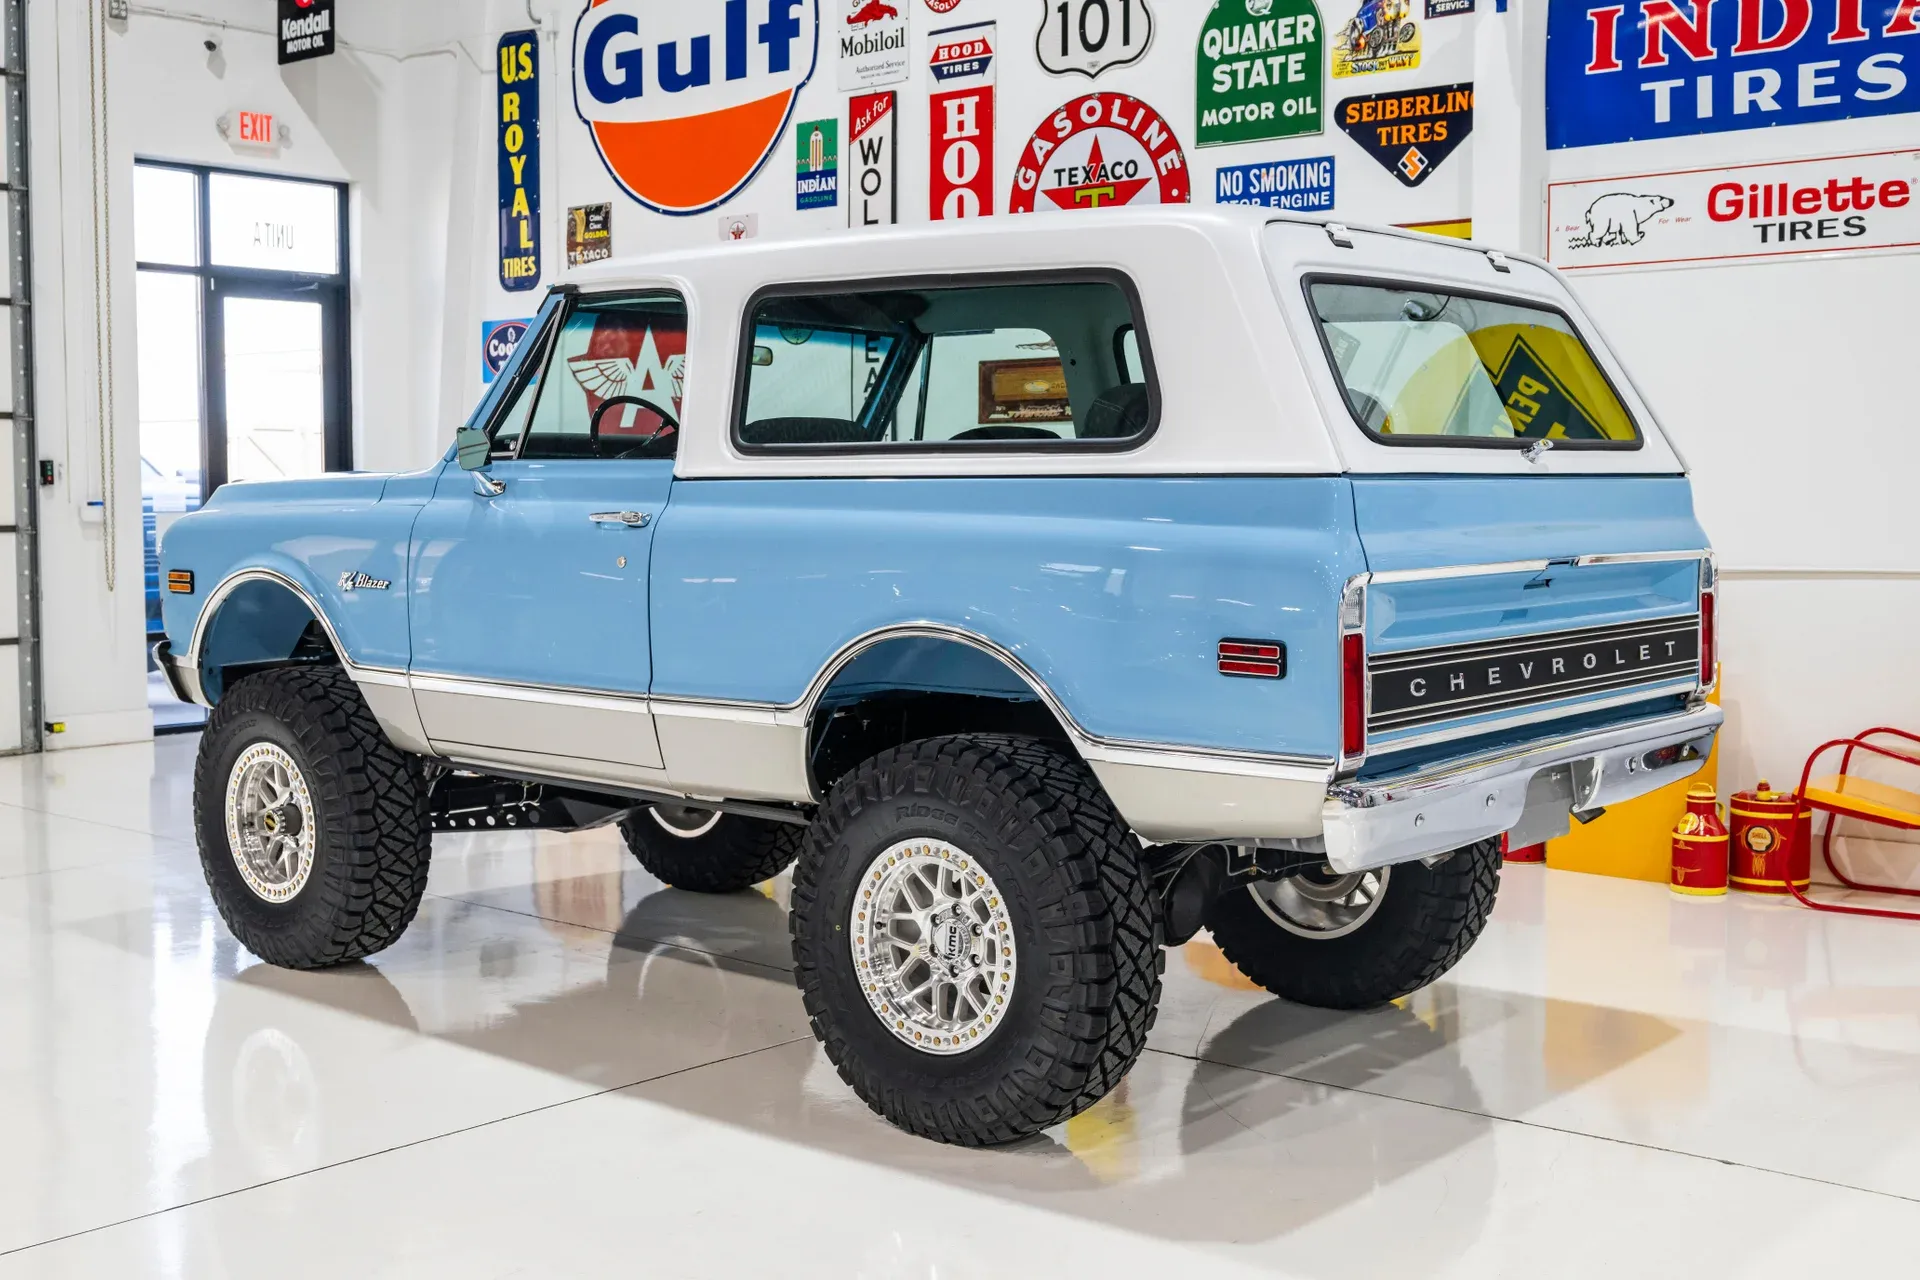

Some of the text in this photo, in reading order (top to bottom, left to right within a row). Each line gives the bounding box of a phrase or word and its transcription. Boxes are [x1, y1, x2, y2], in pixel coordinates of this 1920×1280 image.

[1435, 1, 1470, 13] SERVICE
[282, 9, 330, 40] Kendall
[1057, 0, 1130, 57] 101
[1203, 14, 1316, 61] QUAKER
[286, 33, 325, 54] MOTOR OIL
[584, 0, 801, 104] Gulf
[841, 26, 905, 59] Mobiloil
[938, 42, 984, 60] HOOD
[501, 42, 535, 84] U.S.
[941, 61, 980, 75] TIRES
[1212, 52, 1306, 93] STATE
[1351, 60, 1378, 74] STOCK
[1640, 52, 1908, 123] TIRES
[240, 111, 272, 142] EXIT
[854, 96, 889, 135] Ask for
[1201, 96, 1317, 127] MOTOR OIL
[1018, 98, 1182, 191] GASOLINE
[1377, 120, 1448, 148] TIRES
[503, 92, 534, 250] ROYAL
[797, 175, 836, 194] INDIAN
[1054, 159, 1139, 187] TEXACO
[1220, 161, 1331, 197] NO SMOKING
[800, 194, 833, 204] GASOLINE
[1270, 191, 1331, 209] ENGINE
[1707, 176, 1910, 222] Gillette
[584, 230, 608, 239] GOLDEN
[1753, 215, 1867, 243] TIRES
[503, 256, 536, 279] TIRES
[569, 249, 609, 262] TEXACO
[355, 573, 390, 590] Blazer
[1410, 640, 1676, 698] CHEVROLET
[1751, 831, 1768, 840] SHELL
[946, 926, 957, 957] kmc
